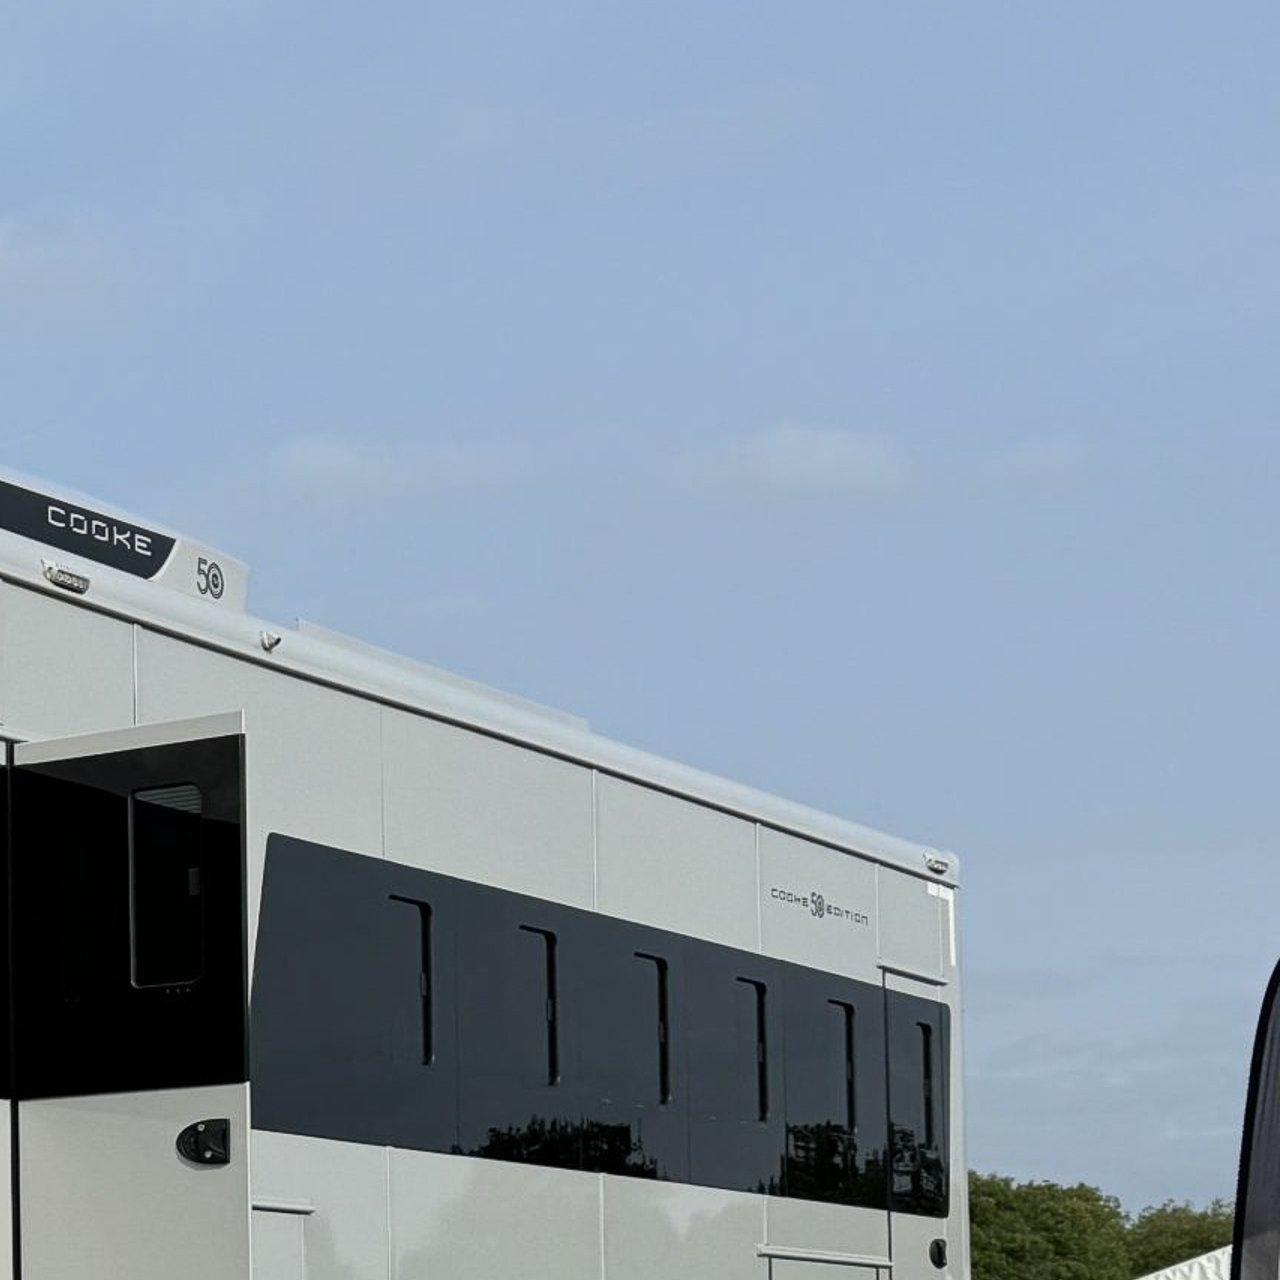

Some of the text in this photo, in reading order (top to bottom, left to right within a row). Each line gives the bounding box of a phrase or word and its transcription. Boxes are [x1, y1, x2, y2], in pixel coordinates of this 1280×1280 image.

[47, 505, 152, 557] COOKE
[196, 556, 225, 599] 50
[770, 888, 868, 926] COOKE 50 EDITION
